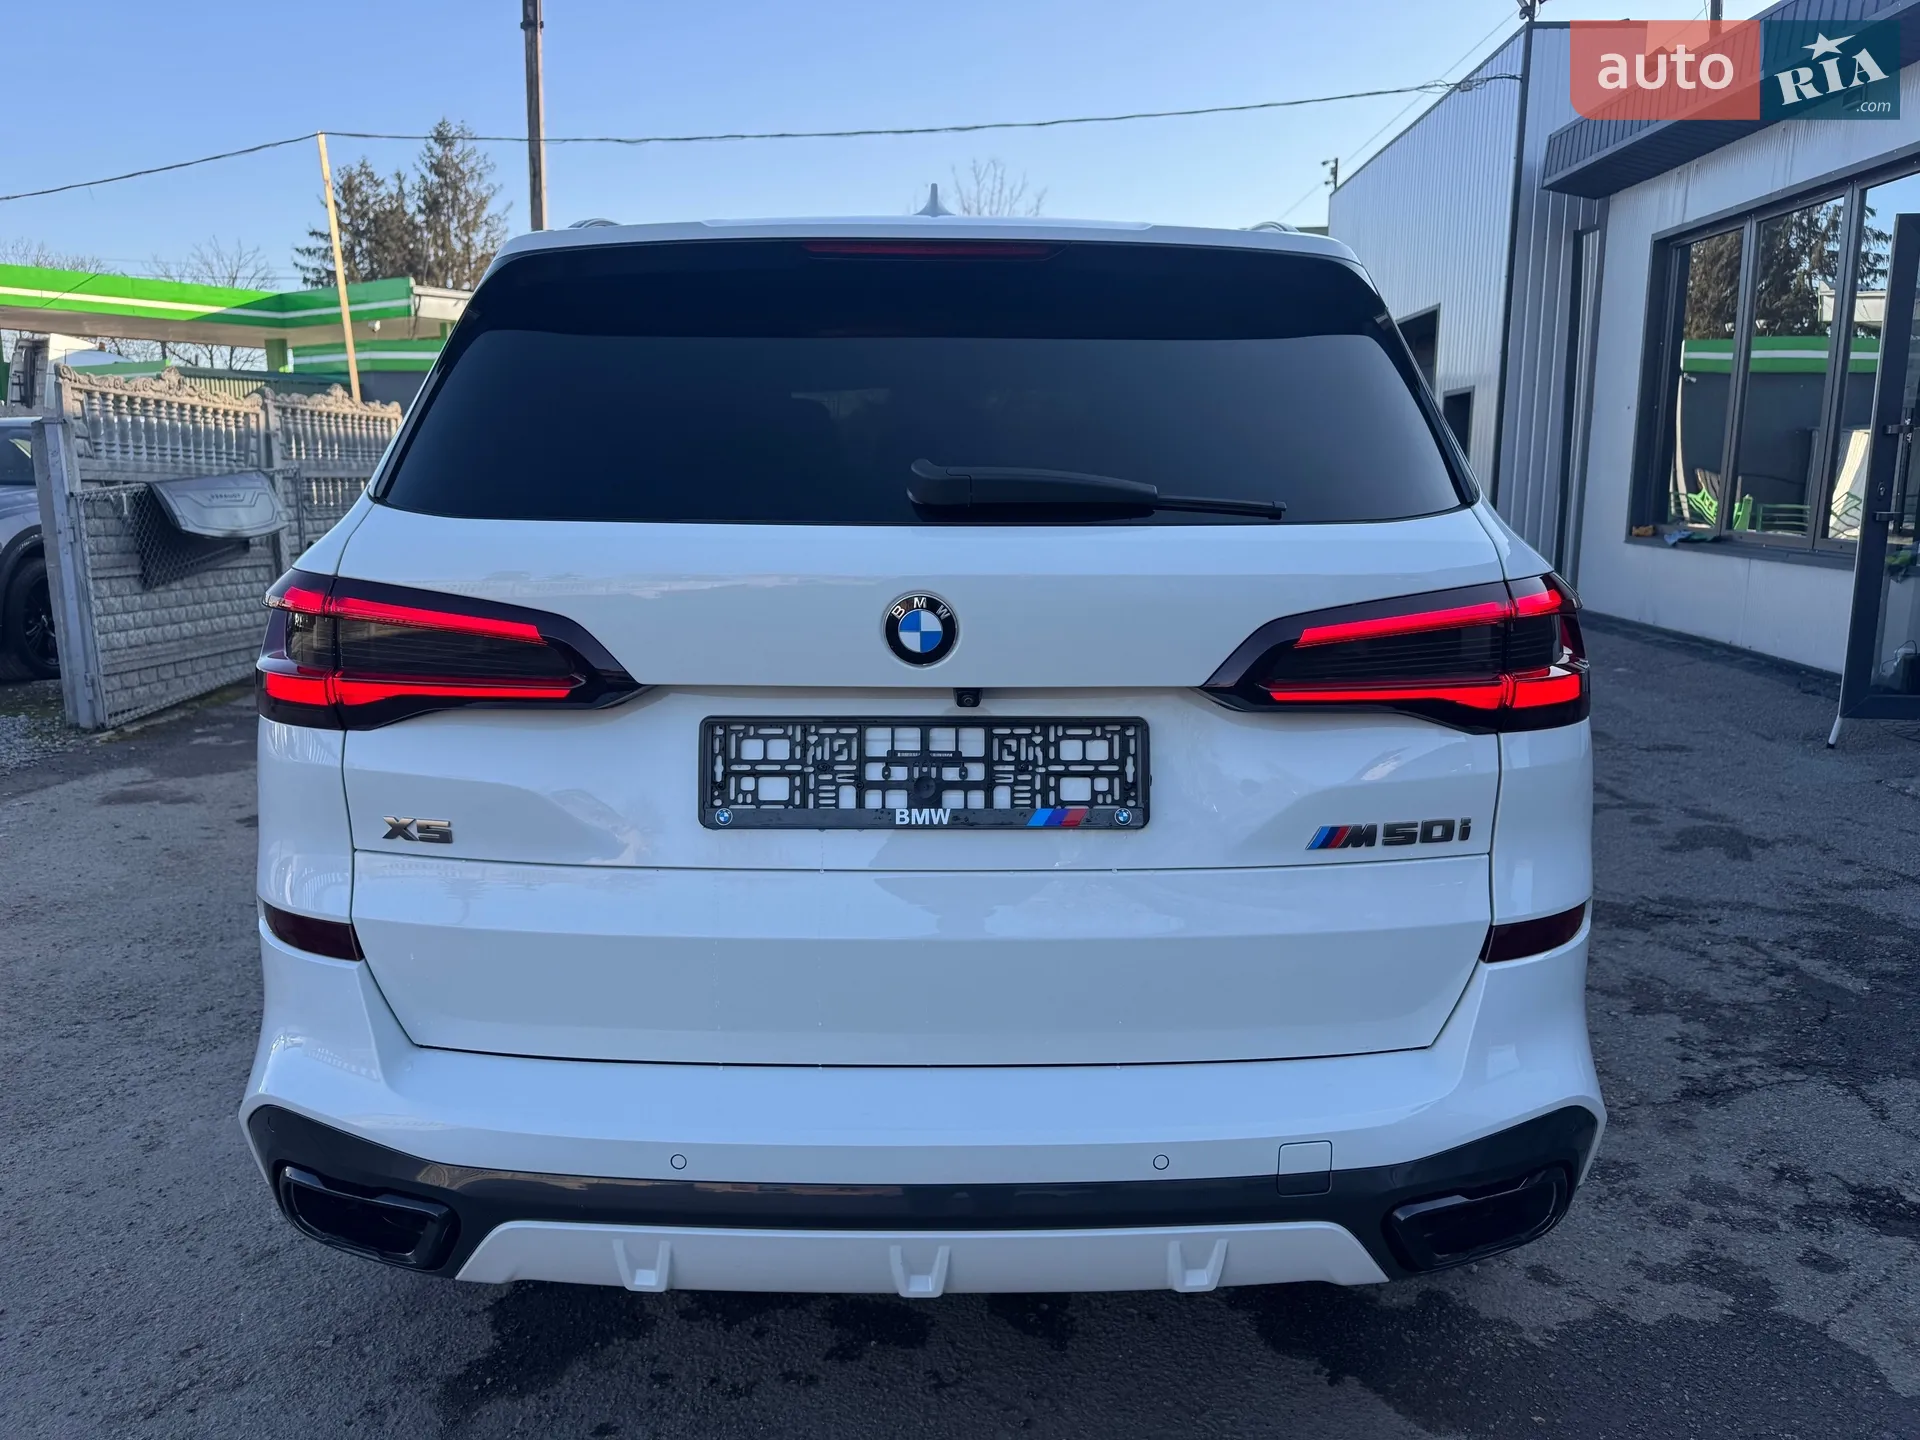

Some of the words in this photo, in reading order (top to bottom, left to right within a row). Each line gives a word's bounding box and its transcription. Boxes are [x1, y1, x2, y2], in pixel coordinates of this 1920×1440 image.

[891, 596, 951, 620] BMW
[382, 815, 453, 844] X5
[895, 808, 951, 825] BMW
[1337, 816, 1471, 848] M50i
